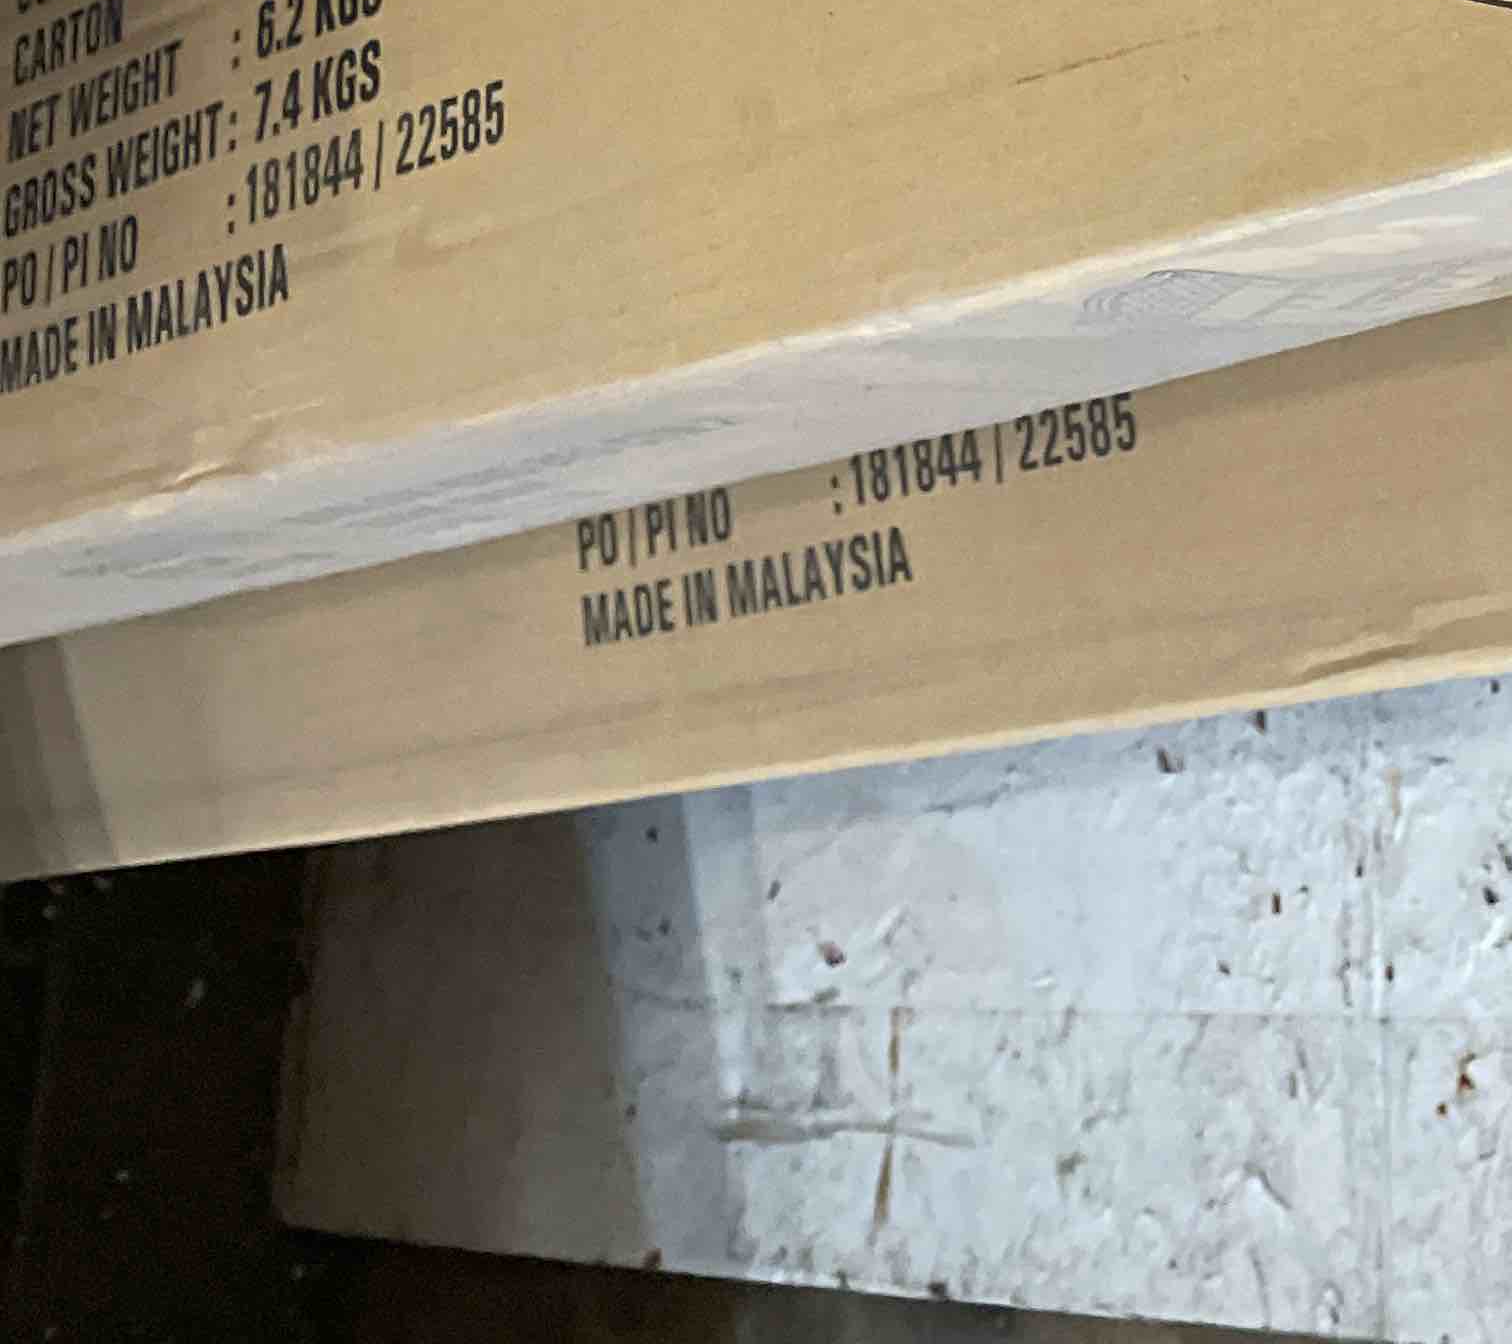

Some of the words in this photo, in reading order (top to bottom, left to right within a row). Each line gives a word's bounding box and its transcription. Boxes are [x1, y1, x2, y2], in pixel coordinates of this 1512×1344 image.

[2, 152, 97, 239] GROSS
[106, 100, 225, 199] WEIGHT
[254, 68, 303, 143] 7.4
[312, 38, 383, 121] KGS
[8, 92, 62, 162] NET
[69, 39, 184, 138] WEIGHT
[3, 251, 38, 313] PO
[62, 231, 89, 294] PI
[98, 214, 139, 281] NO
[394, 79, 505, 175] 22585
[0, 315, 79, 394] MADE
[89, 302, 118, 367] IN
[127, 242, 289, 355] MALAYSIA
[577, 513, 617, 571] PO
[646, 499, 677, 556] PI
[687, 486, 734, 546] NO
[1016, 391, 1138, 471] 22585
[580, 582, 676, 647] MADE
[684, 566, 718, 627] IN
[727, 526, 914, 618] MALAYSIA
